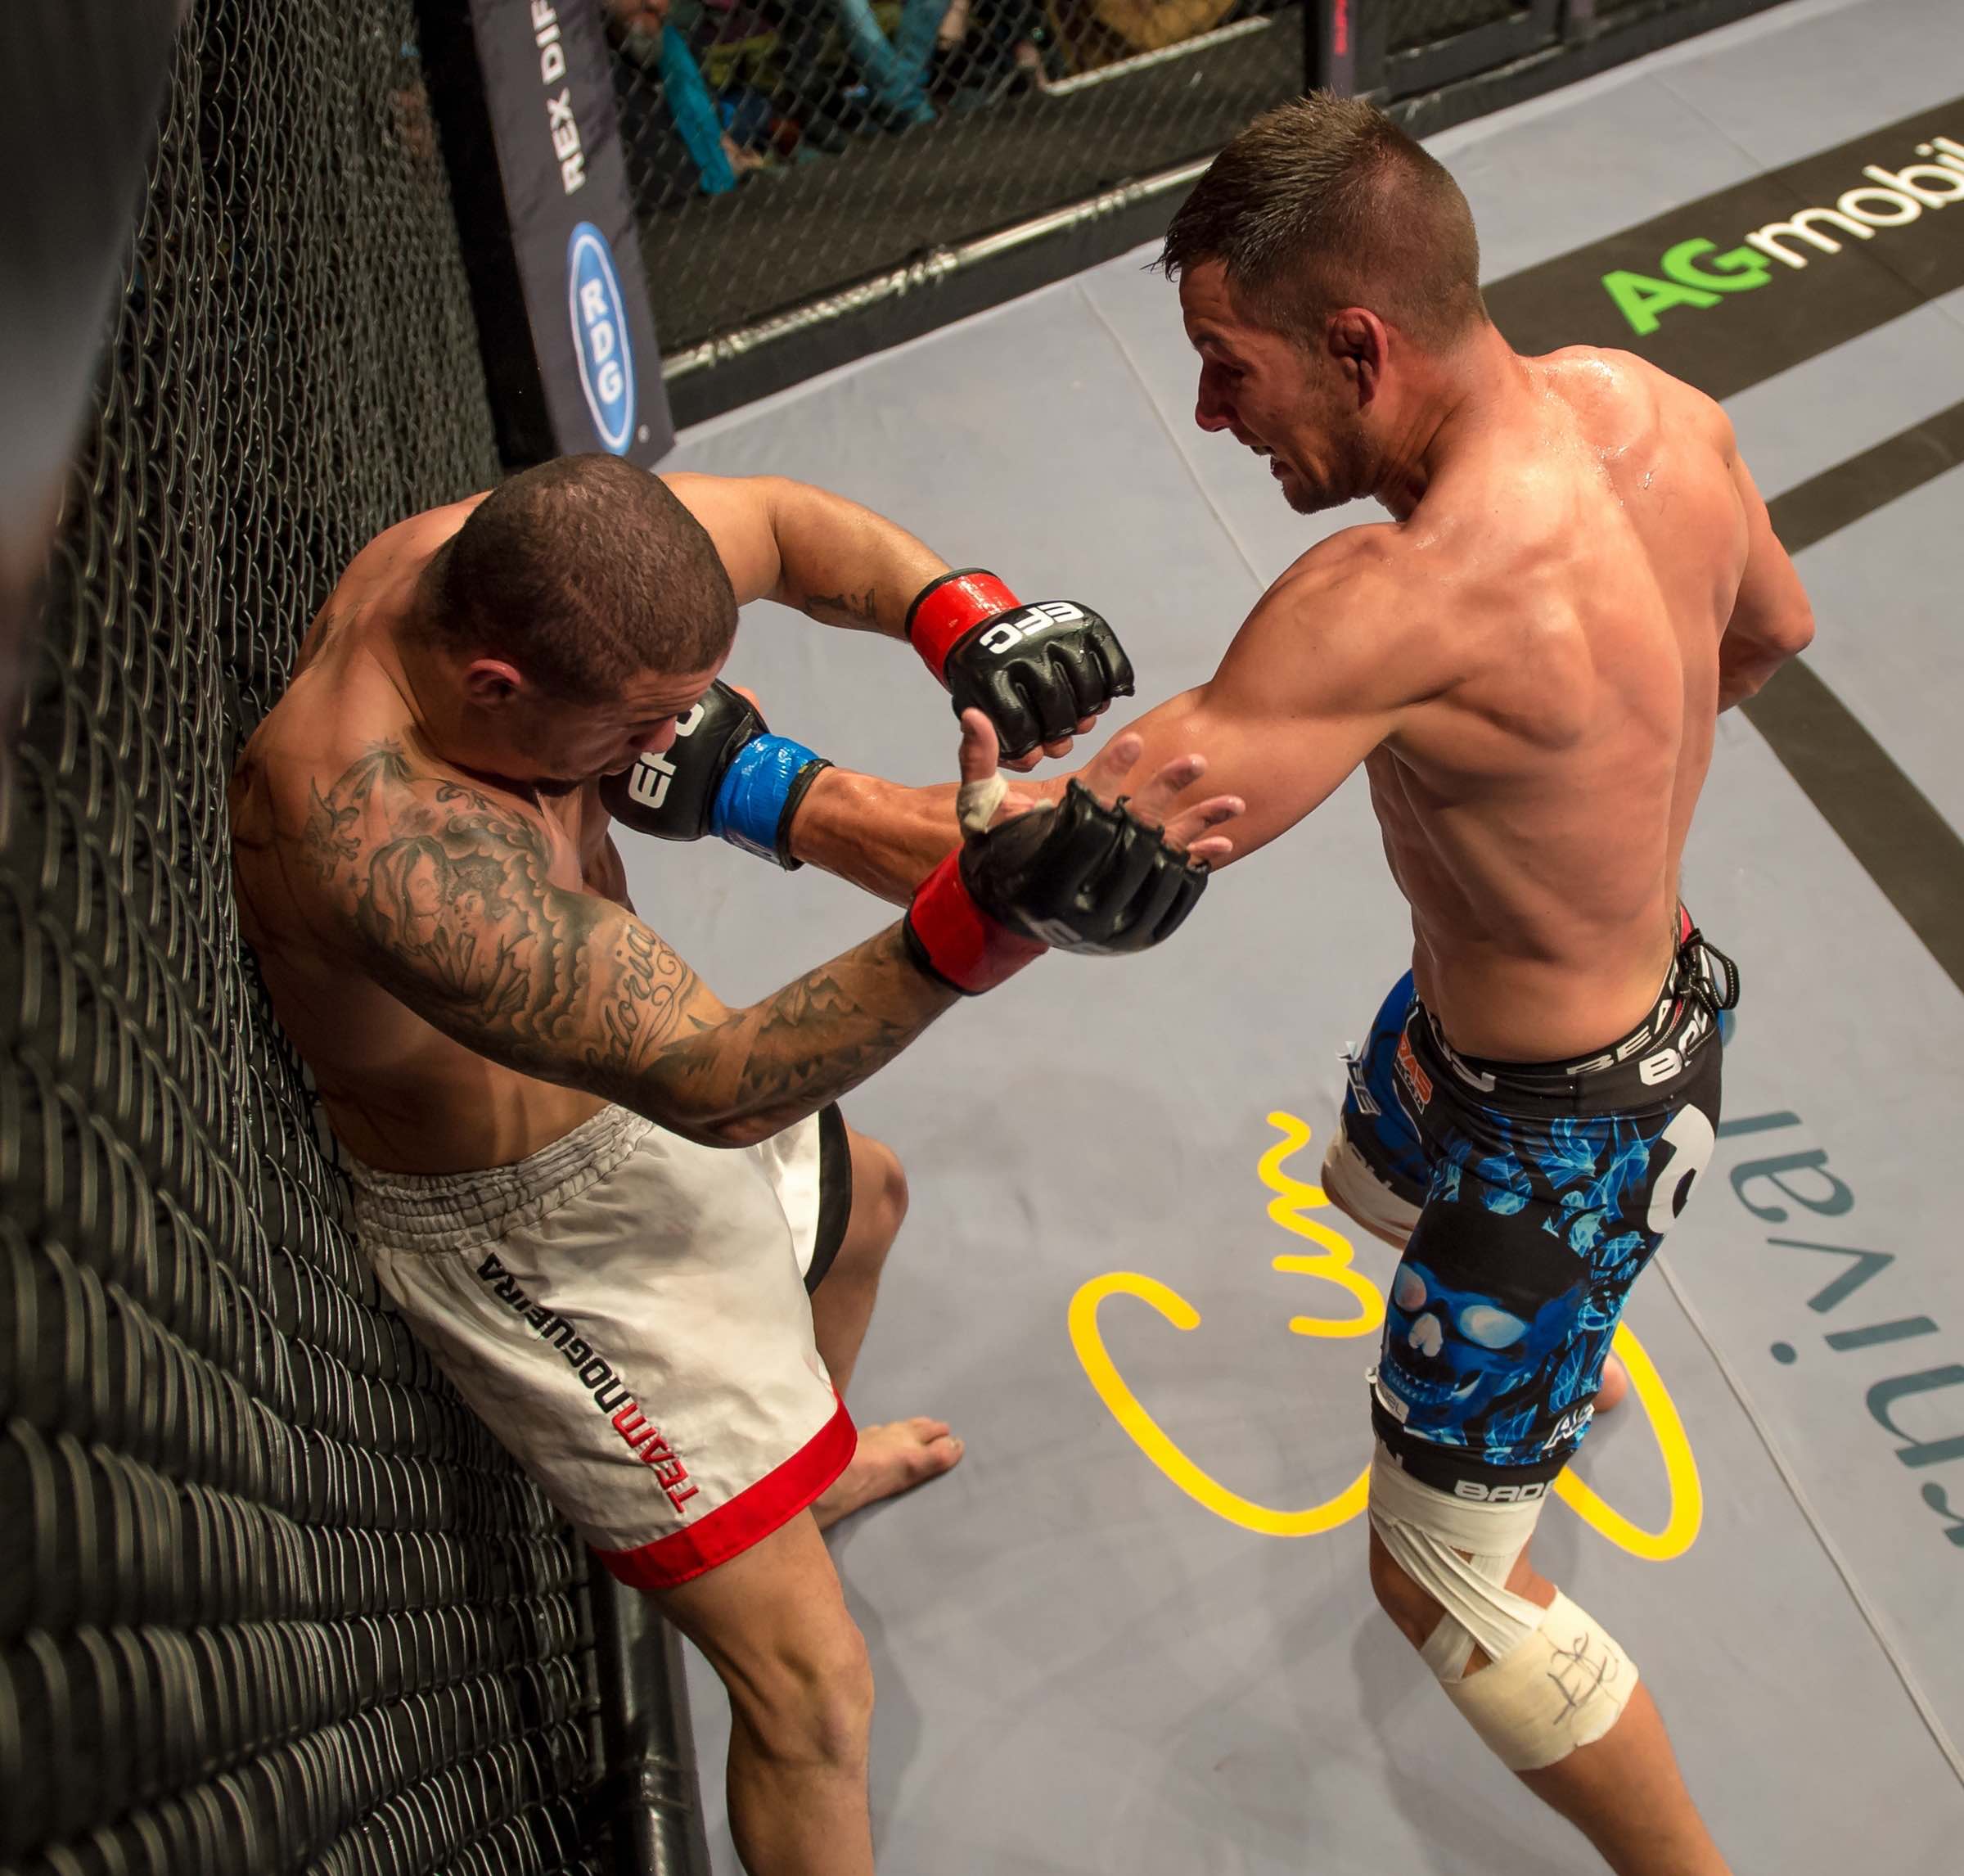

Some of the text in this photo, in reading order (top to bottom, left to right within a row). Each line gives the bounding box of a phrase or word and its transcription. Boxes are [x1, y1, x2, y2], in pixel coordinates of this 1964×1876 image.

[547, 88, 585, 195] REX
[580, 278, 624, 404] RDG
[979, 602, 1084, 654] EFC
